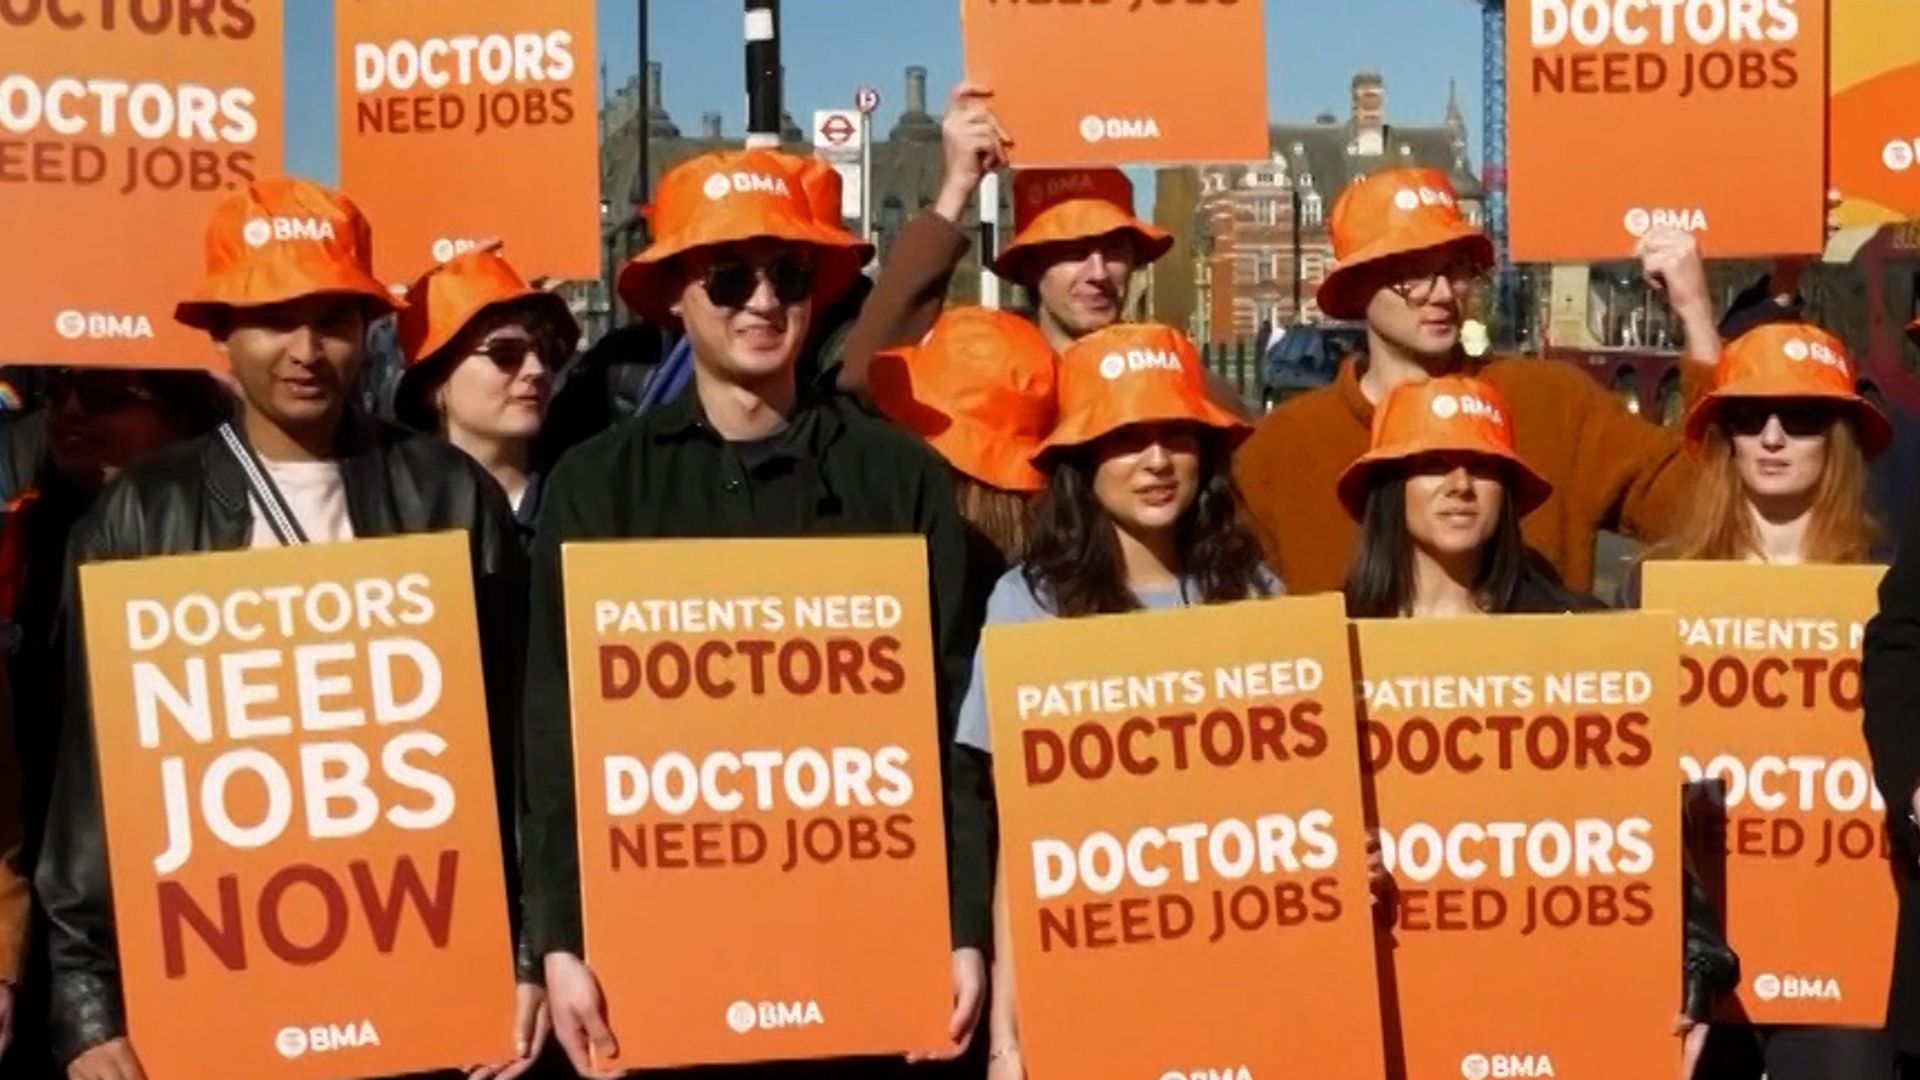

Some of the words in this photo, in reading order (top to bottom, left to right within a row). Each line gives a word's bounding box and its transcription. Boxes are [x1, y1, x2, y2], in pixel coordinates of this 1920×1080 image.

[1531, 0, 1799, 47] DOCTORS
[355, 29, 574, 93] DOCTORS
[1532, 52, 1667, 93] NEED
[1678, 48, 1799, 97] JOBS
[0, 73, 258, 143] OCTORS
[357, 94, 465, 135] NEED
[475, 87, 574, 136] JOBS
[1106, 118, 1160, 139] BMA
[0, 141, 107, 183] EED
[120, 145, 256, 195] JOBS
[733, 171, 793, 198] BMA
[273, 216, 335, 242] BMA
[88, 313, 154, 339] BMA
[1127, 347, 1183, 373] BMA
[126, 573, 435, 651] DOCTORS
[595, 596, 785, 634] PATIENTS
[795, 594, 903, 630] NEED
[132, 636, 442, 749] NEED
[598, 635, 906, 701] DOCTORS
[1017, 670, 1206, 721] PATIENTS
[1214, 658, 1324, 700] NEED
[1545, 670, 1653, 707] NEED
[1022, 701, 1328, 787] DOCTORS
[154, 730, 456, 874] JOBS
[603, 745, 914, 816] DOCTORS
[1679, 754, 1887, 812] OCTO
[608, 821, 768, 873] NEED
[781, 813, 917, 873] JOBS
[1031, 808, 1339, 900] DOCTORS
[1724, 818, 1804, 858] ED
[1815, 818, 1891, 868] JO
[156, 850, 459, 979] NOW
[1038, 892, 1195, 952] NEED
[1208, 876, 1342, 944] JOBS
[1399, 888, 1508, 932] EED
[1521, 882, 1654, 936] JOBS
[1783, 974, 1842, 1001] BMA
[309, 1018, 380, 1052] BMA
[758, 1000, 824, 1030] BMA
[1491, 1053, 1555, 1079] BMA
